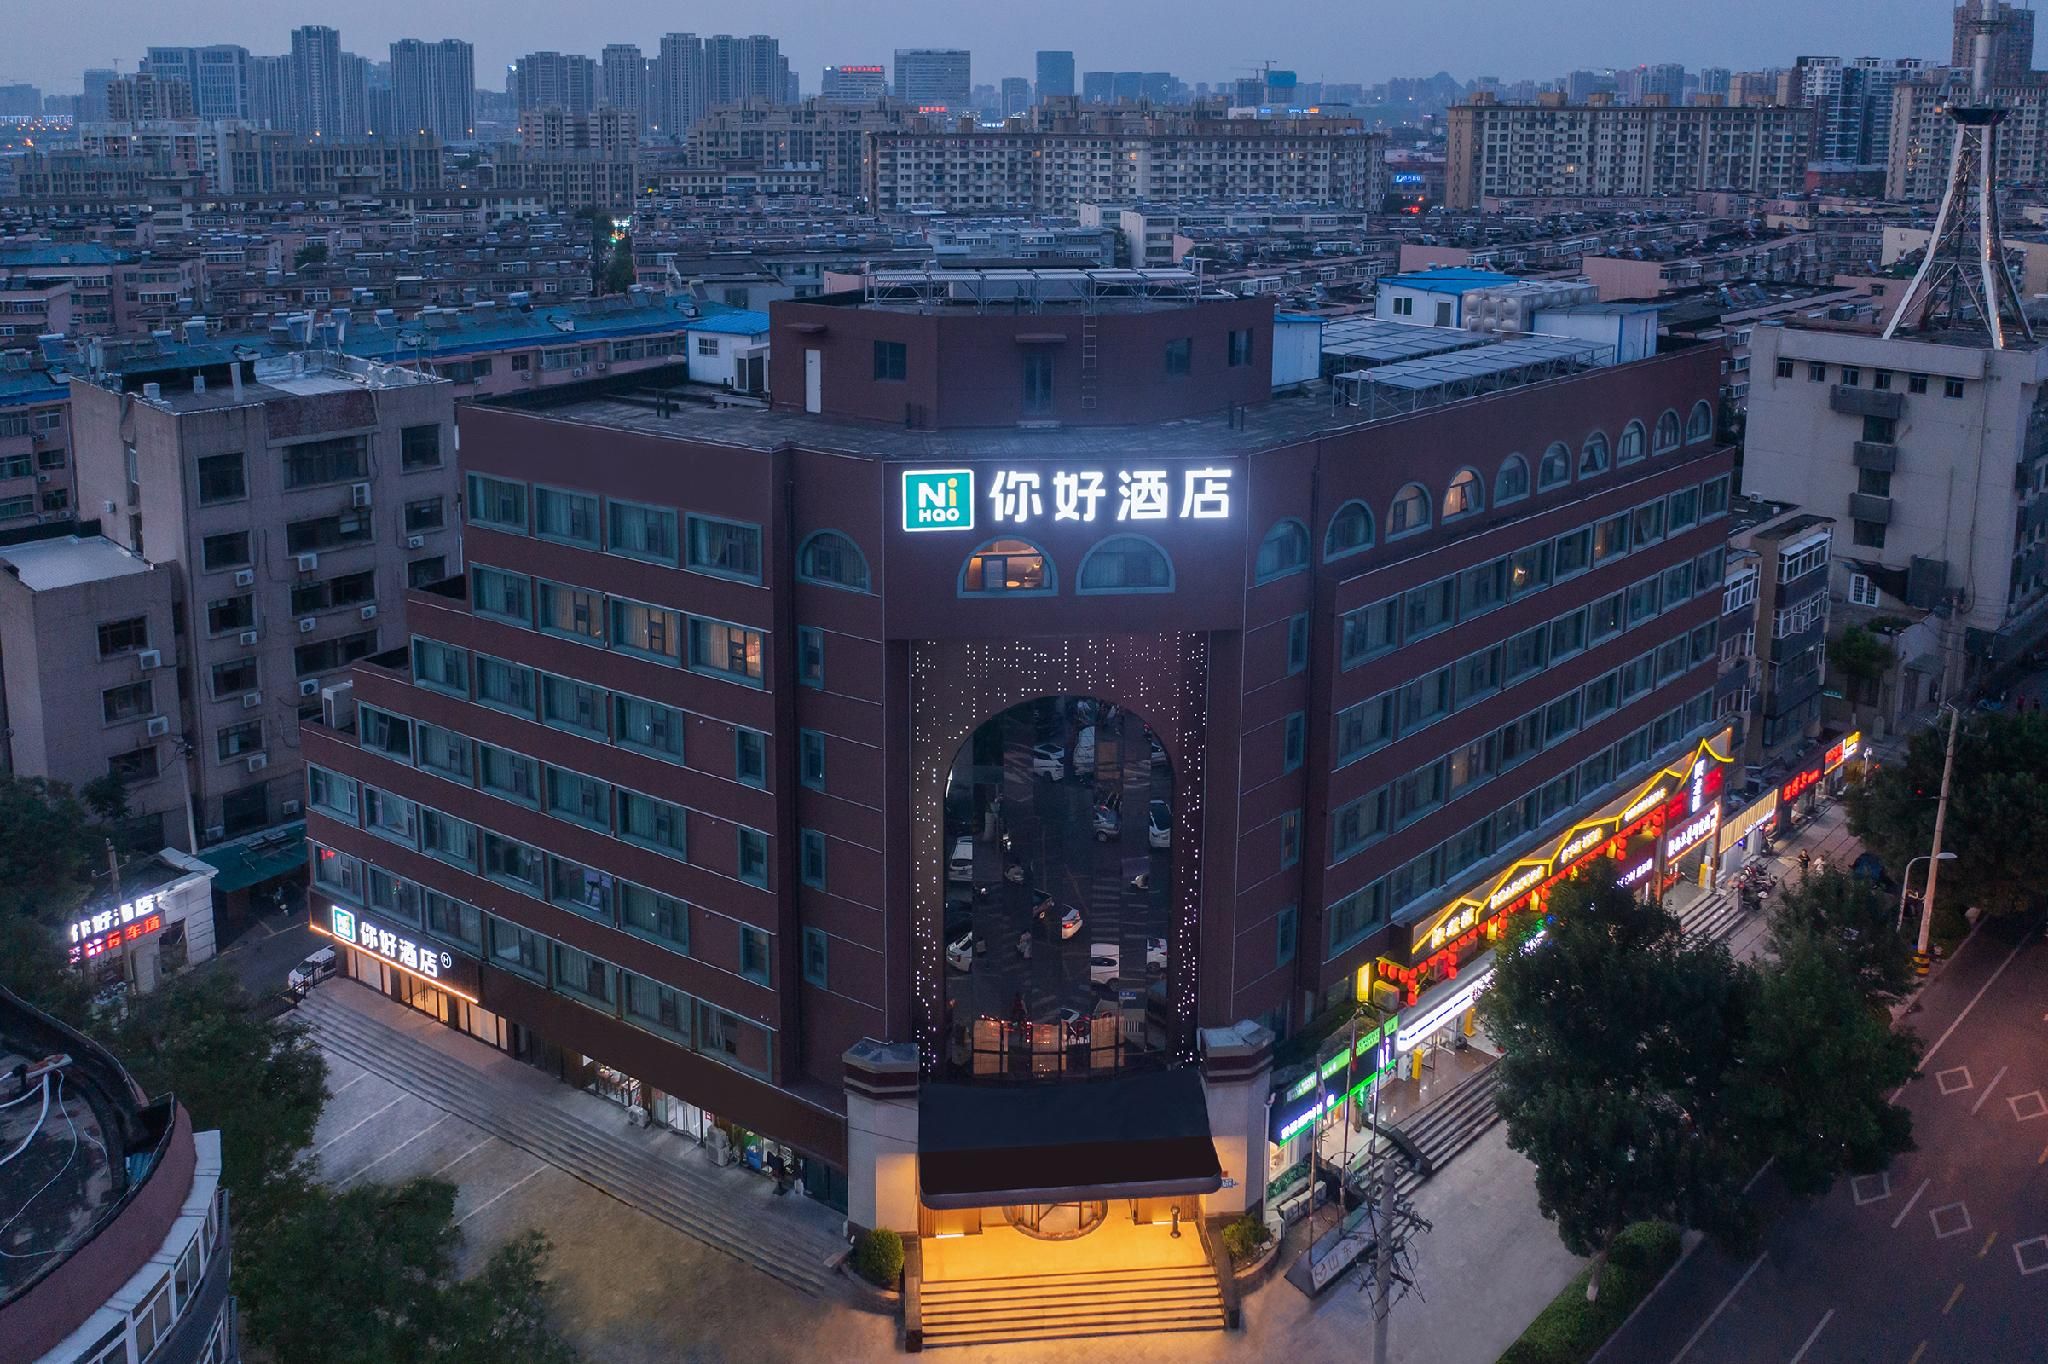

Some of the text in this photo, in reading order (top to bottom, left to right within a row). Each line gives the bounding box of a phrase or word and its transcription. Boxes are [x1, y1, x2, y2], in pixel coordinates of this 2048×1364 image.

[918, 478, 958, 508] Ni
[989, 468, 1233, 522] 你好酒店
[360, 921, 438, 978] 你好酒店
